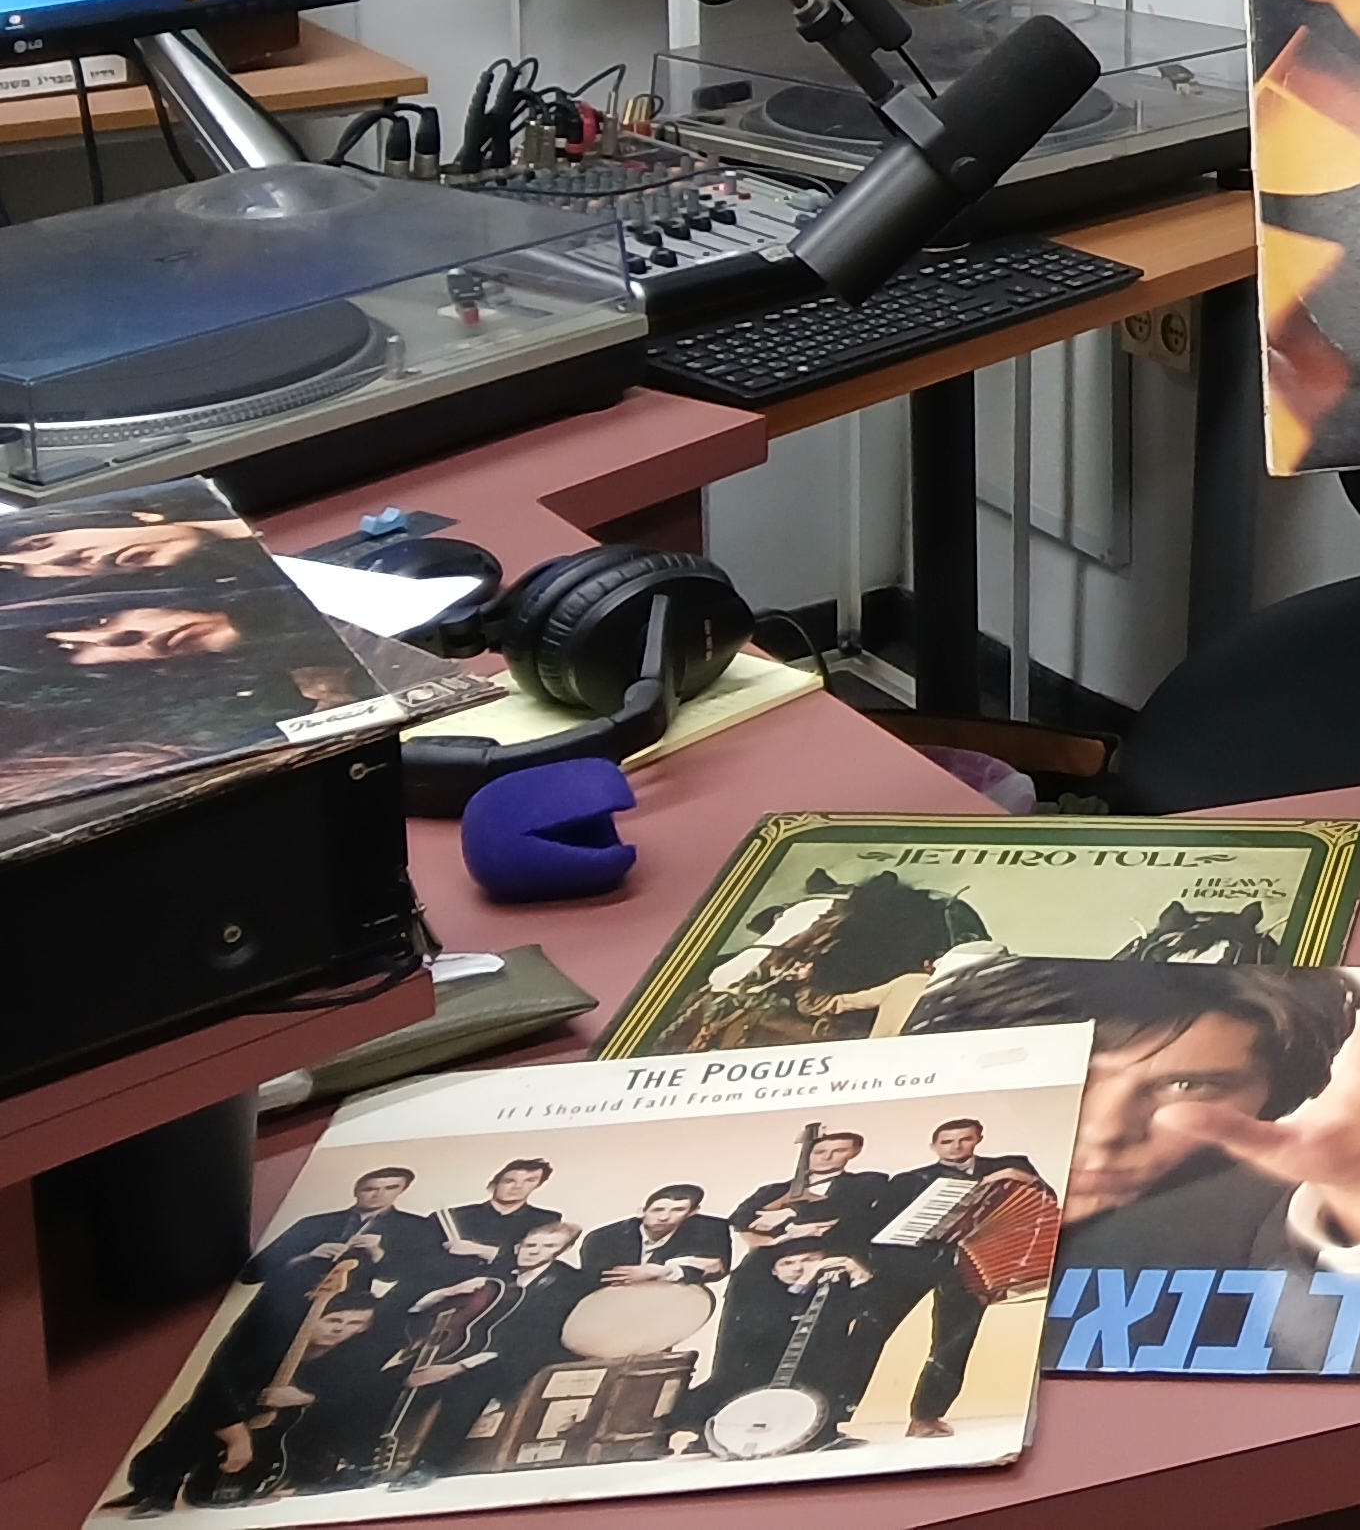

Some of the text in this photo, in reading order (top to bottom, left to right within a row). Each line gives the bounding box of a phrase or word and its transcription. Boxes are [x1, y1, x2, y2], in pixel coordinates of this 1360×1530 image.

[894, 848, 1200, 868] JETHRO TULL
[625, 1055, 834, 1092] THE POGUES
[542, 1099, 623, 1118] Should
[632, 1094, 679, 1109] Fall
[687, 1087, 744, 1104] From
[754, 1084, 819, 1100] Grace
[830, 1076, 883, 1093] With
[894, 1072, 938, 1088] God
[1048, 1268, 1287, 1371] בנאי
